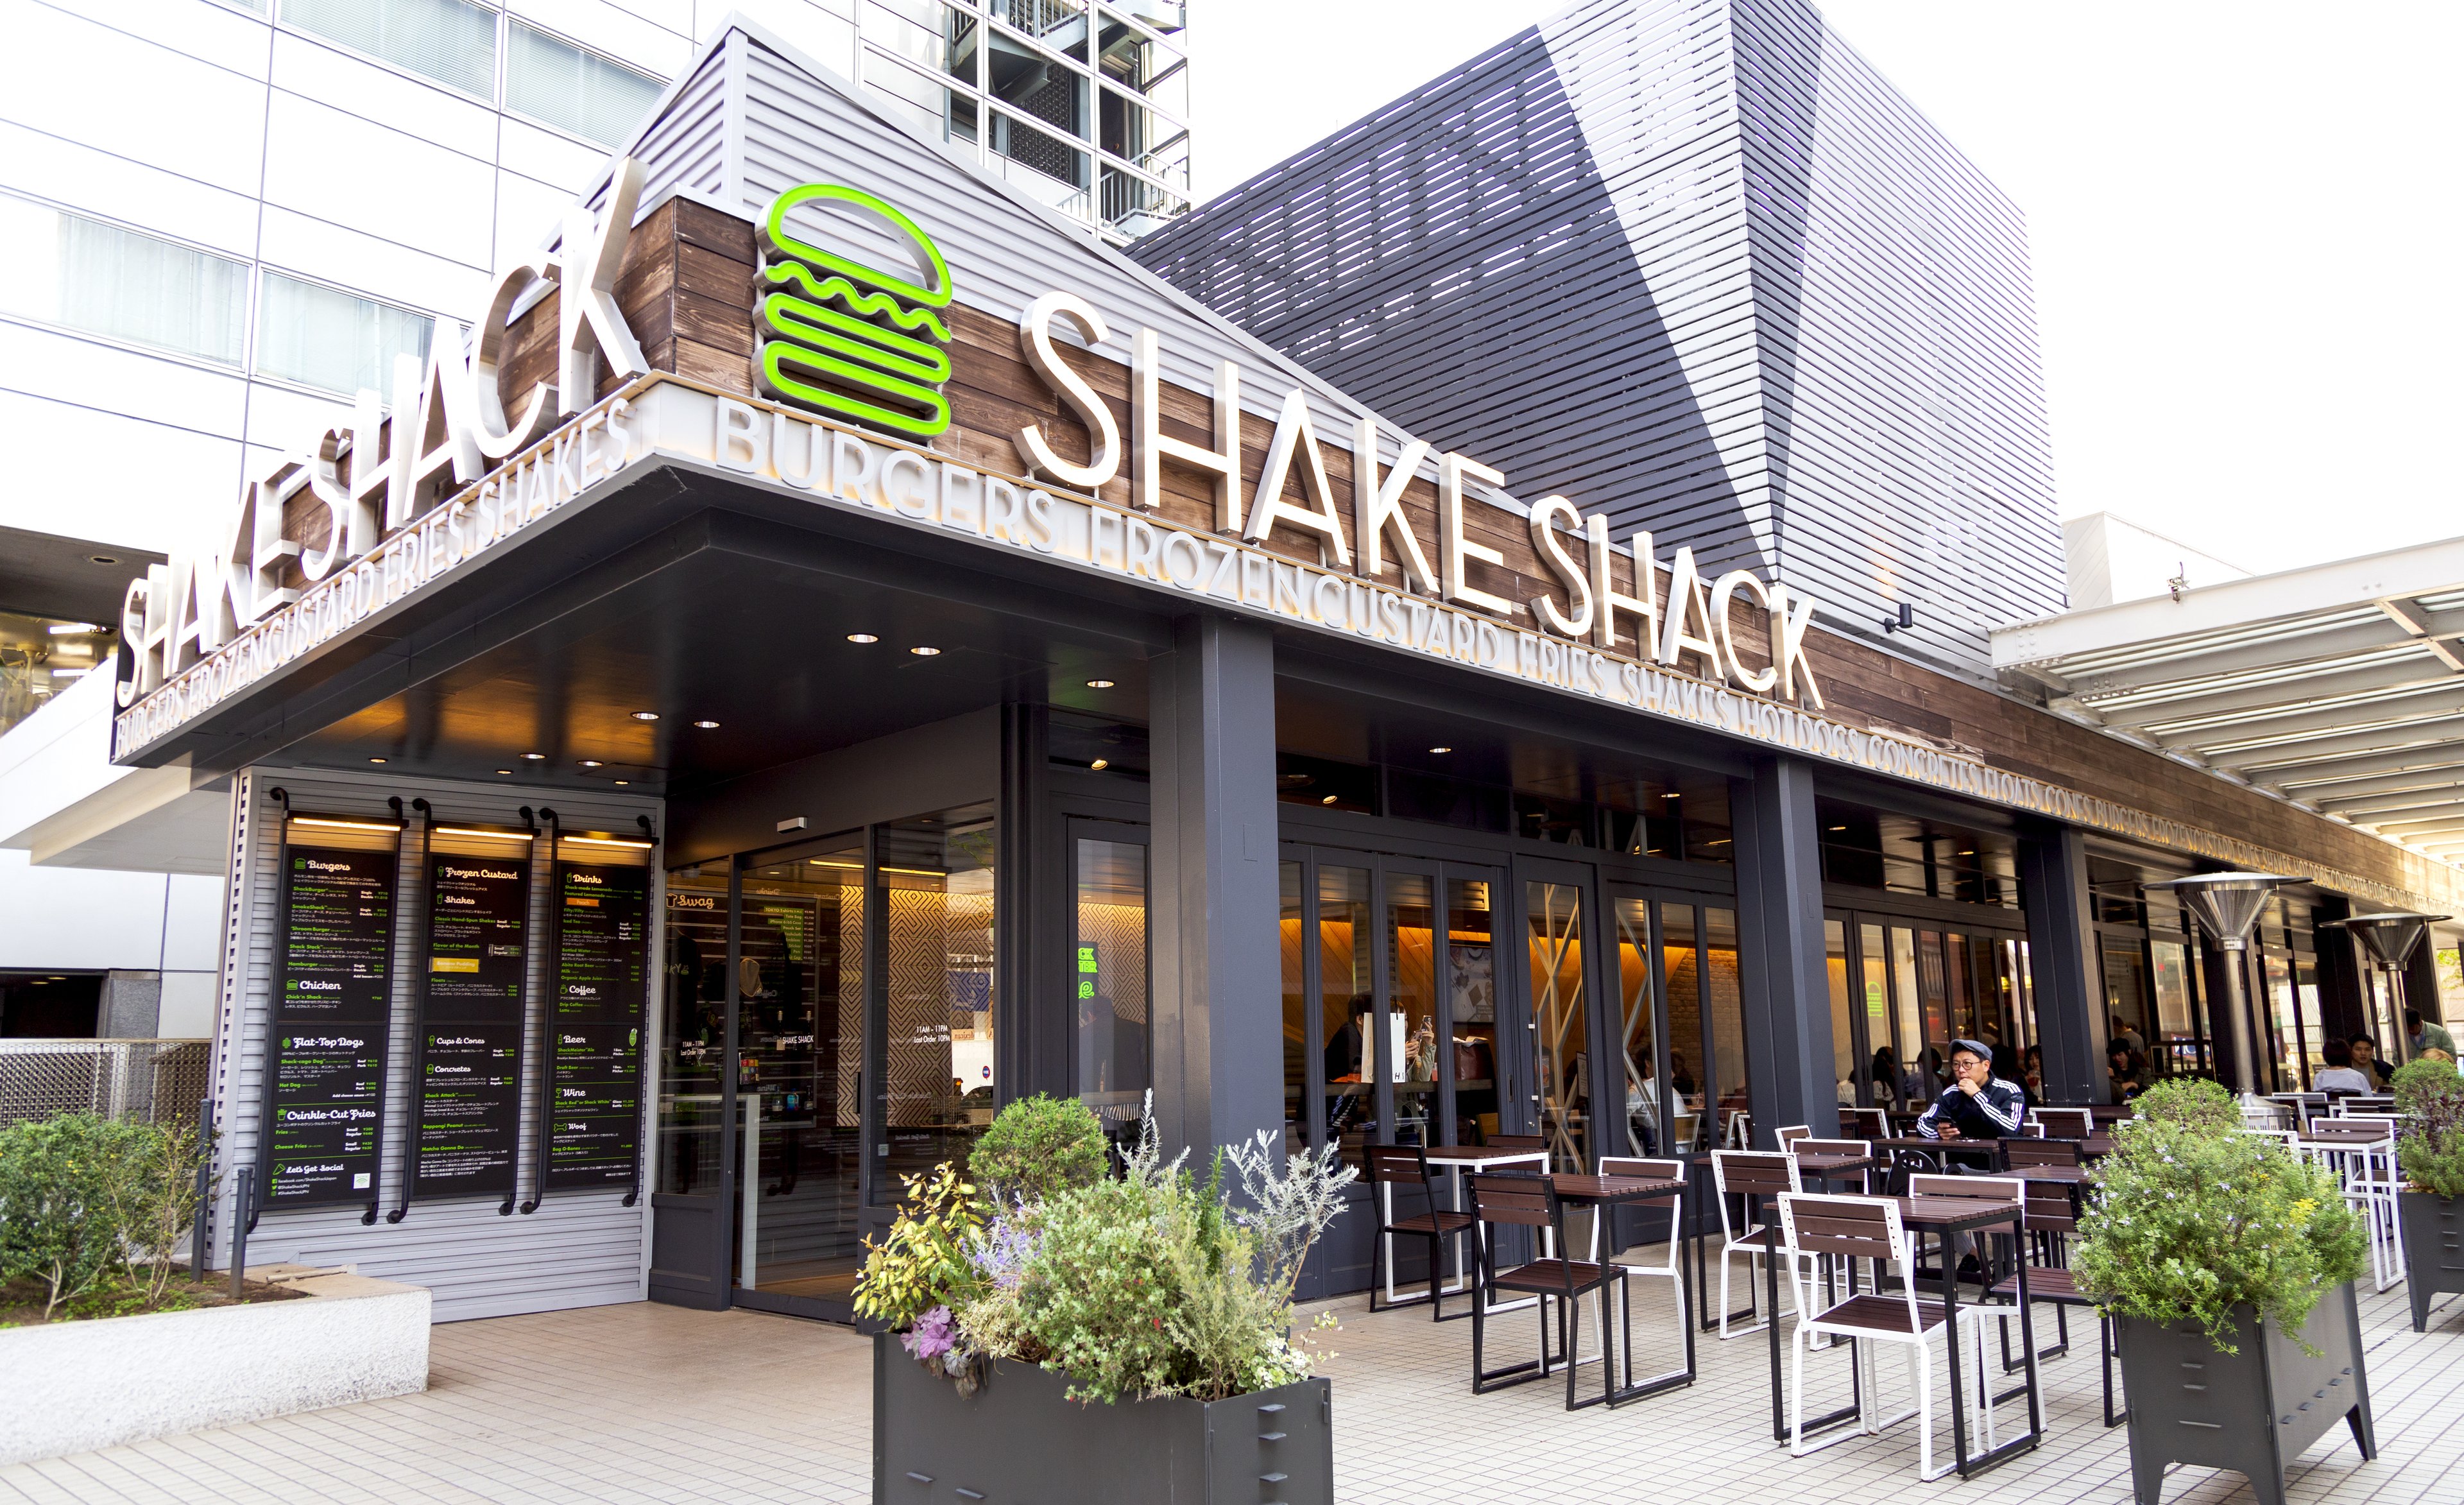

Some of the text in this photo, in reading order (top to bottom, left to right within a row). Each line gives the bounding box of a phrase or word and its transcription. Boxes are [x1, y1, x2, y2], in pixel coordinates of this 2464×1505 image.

[116, 156, 651, 708] SHAKE SHACK
[1013, 291, 1826, 710] SHAKE SHACK
[116, 679, 189, 760] BURGERS
[384, 501, 466, 605] FRIES
[478, 398, 631, 547] SHAKES
[716, 396, 1057, 553] BURGERS
[1519, 630, 1606, 698] FRIES
[1623, 662, 1730, 731] SHAKES
[1869, 735, 1979, 796] CONCRETES
[1984, 766, 2041, 811] FLOATS
[2045, 785, 2092, 823] CONES
[2095, 798, 2149, 838] BURGERS
[307, 860, 351, 872] Burgers
[445, 866, 518, 879] Frozen Custard
[573, 874, 603, 884] Drinks
[444, 895, 475, 904] Shakes
[678, 895, 715, 909] Swag
[300, 980, 342, 990] Chicken
[569, 985, 597, 995] Coffee
[293, 1037, 364, 1049] Flat-Top Dogs
[436, 1037, 455, 1045] Cups
[782, 1035, 814, 1044] SHAKE SHACK
[563, 1088, 586, 1097] Wine
[287, 1108, 376, 1121] Crinkle-Cut Fries
[568, 1122, 587, 1131] Woof
[304, 1165, 318, 1174] Get
[319, 1164, 345, 1172] Social
